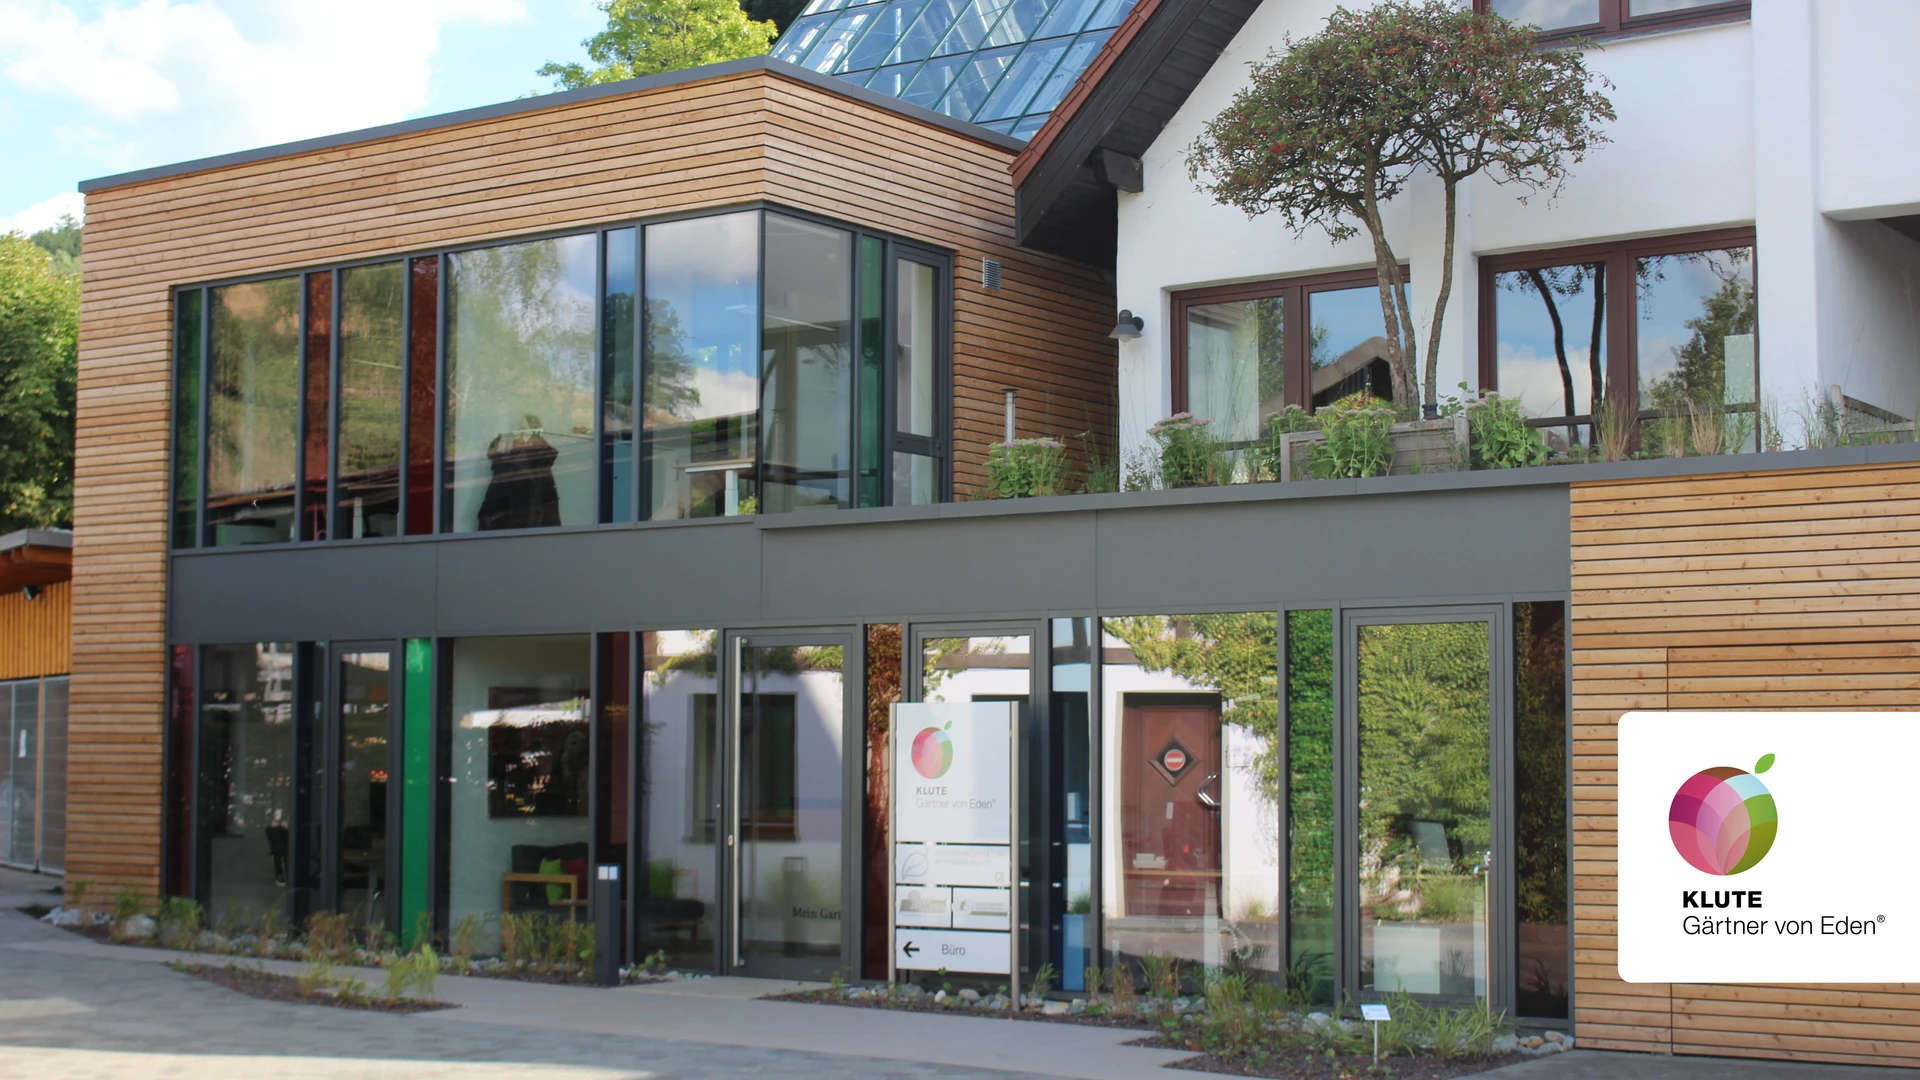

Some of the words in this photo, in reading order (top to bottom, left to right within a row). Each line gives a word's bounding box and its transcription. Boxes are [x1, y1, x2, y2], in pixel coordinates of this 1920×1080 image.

[916, 786, 948, 796] KLUTE
[952, 800, 968, 809] von
[792, 906, 818, 919] Mein
[941, 943, 966, 956] Büro
